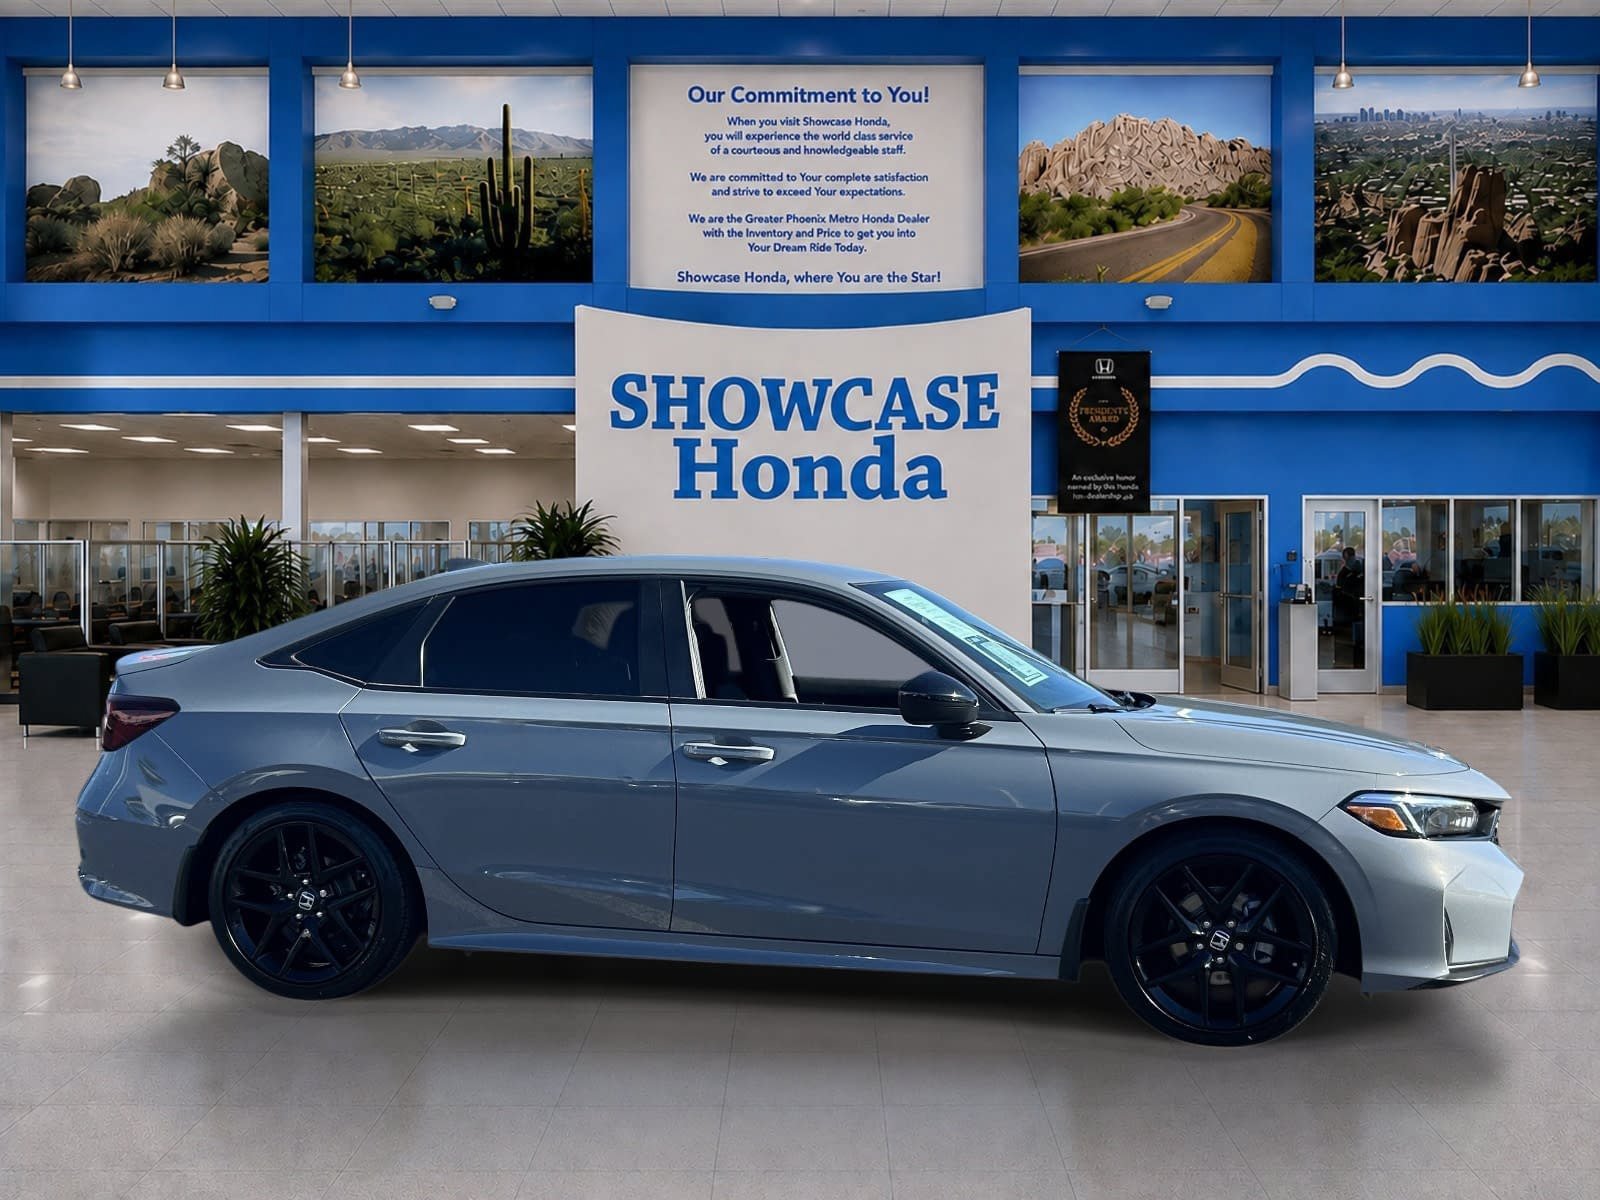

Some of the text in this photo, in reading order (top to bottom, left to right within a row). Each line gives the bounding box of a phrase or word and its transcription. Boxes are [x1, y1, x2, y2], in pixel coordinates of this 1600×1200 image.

[688, 86, 928, 104] Our Commitment to You!
[726, 116, 891, 129] When you visit Showcase Honda,
[704, 130, 914, 144] you will experience the world class service
[710, 144, 721, 155] of
[730, 146, 781, 156] courteous
[782, 144, 802, 155] and
[881, 144, 906, 155] staff.
[689, 171, 929, 185] We are committed to Your complete satisfaction
[711, 186, 906, 200] and strive to exceed Your expectations.
[688, 213, 931, 224] We are the Greater Phoenix Metro Honda Dealer
[702, 227, 917, 241] with the Inventory and Price to get you into
[747, 242, 867, 255] Your Dream Ride Today.
[677, 270, 941, 286] Showcase Honda, where You are the Star!
[609, 372, 1001, 432] SHOWCASE
[672, 433, 949, 501] Honda
